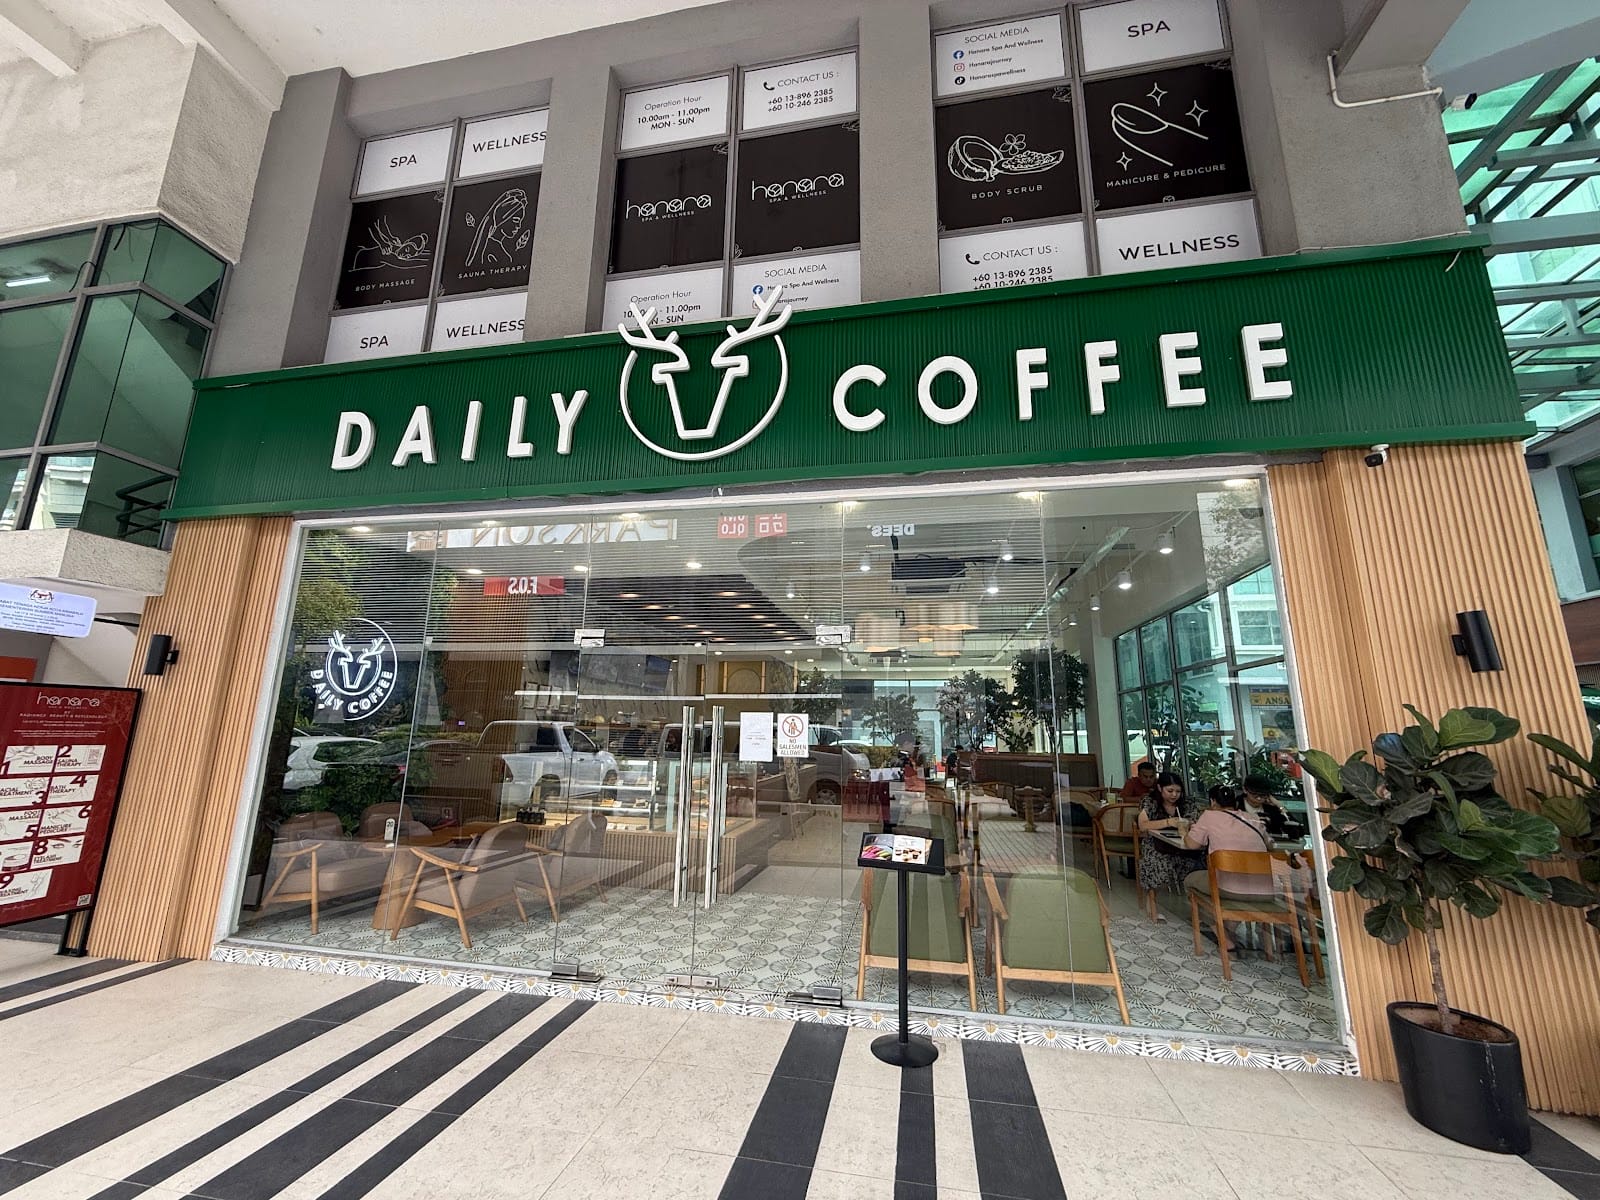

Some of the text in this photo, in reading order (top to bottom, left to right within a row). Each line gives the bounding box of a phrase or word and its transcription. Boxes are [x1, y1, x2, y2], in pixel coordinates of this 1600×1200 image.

[964, 27, 1029, 44] SOCIAL MEDIA
[1127, 20, 1170, 38] SPA
[1018, 39, 1044, 47] Wellness
[778, 74, 820, 87] CONTACT
[822, 71, 834, 80] US
[645, 96, 702, 111] Operation Hour
[768, 88, 833, 105] +60 13-896 2385
[768, 96, 833, 112] +60 10-246 2385
[638, 114, 670, 124] 10.00am
[678, 107, 710, 117] 11.00pm
[651, 121, 671, 130] MON
[679, 117, 695, 126] SUN
[472, 131, 547, 153] WELLNESS
[389, 154, 417, 168] SPA
[1106, 164, 1226, 188] MANICURE & PEDICURE
[752, 173, 844, 200] hanara
[971, 184, 1043, 200] BODY SCRUB
[791, 190, 827, 200] WELLNESS
[626, 194, 712, 219] hanara
[983, 248, 1034, 261] CONTACT
[1037, 246, 1052, 255] US
[1119, 234, 1240, 260] WELLNESS
[458, 264, 528, 279] SAUNA THERAPY
[764, 264, 827, 278] SOCIAL MEDIA
[973, 266, 1053, 282] +60 13-896 2385
[355, 279, 415, 292] BODY MASSAGE
[630, 294, 669, 304] Operation
[666, 304, 701, 314] 11.00pm
[666, 315, 684, 323] SUN
[446, 319, 525, 339] WELLNESS
[360, 336, 389, 349] SPA
[331, 322, 1293, 471] DAILY COFFEE
[310, 669, 394, 714] DAILY COFFEE
[36, 692, 100, 707] hanara
[57, 745, 72, 758] 2
[70, 775, 87, 787] 4
[32, 791, 47, 805] 3
[78, 805, 92, 818] 6
[24, 825, 40, 839] 5
[33, 838, 48, 855] 8
